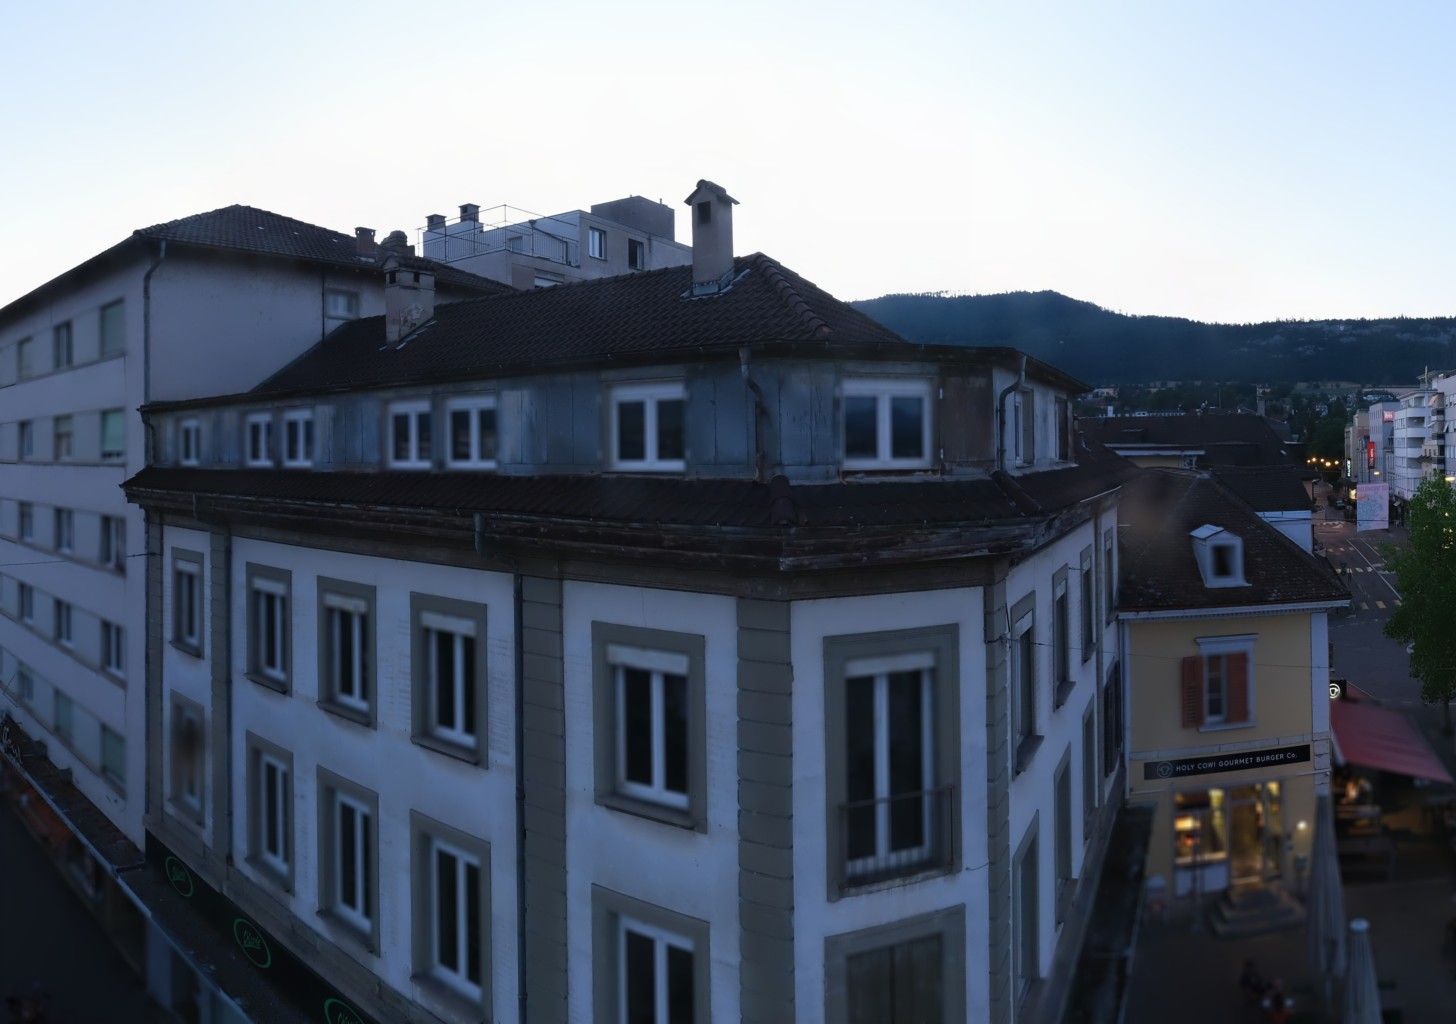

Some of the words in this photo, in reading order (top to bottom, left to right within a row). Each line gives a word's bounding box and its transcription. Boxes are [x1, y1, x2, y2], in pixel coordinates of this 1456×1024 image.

[1176, 764, 1195, 772] HOLY
[1219, 757, 1253, 767] GOURMET
[1256, 753, 1285, 763] BURGER
